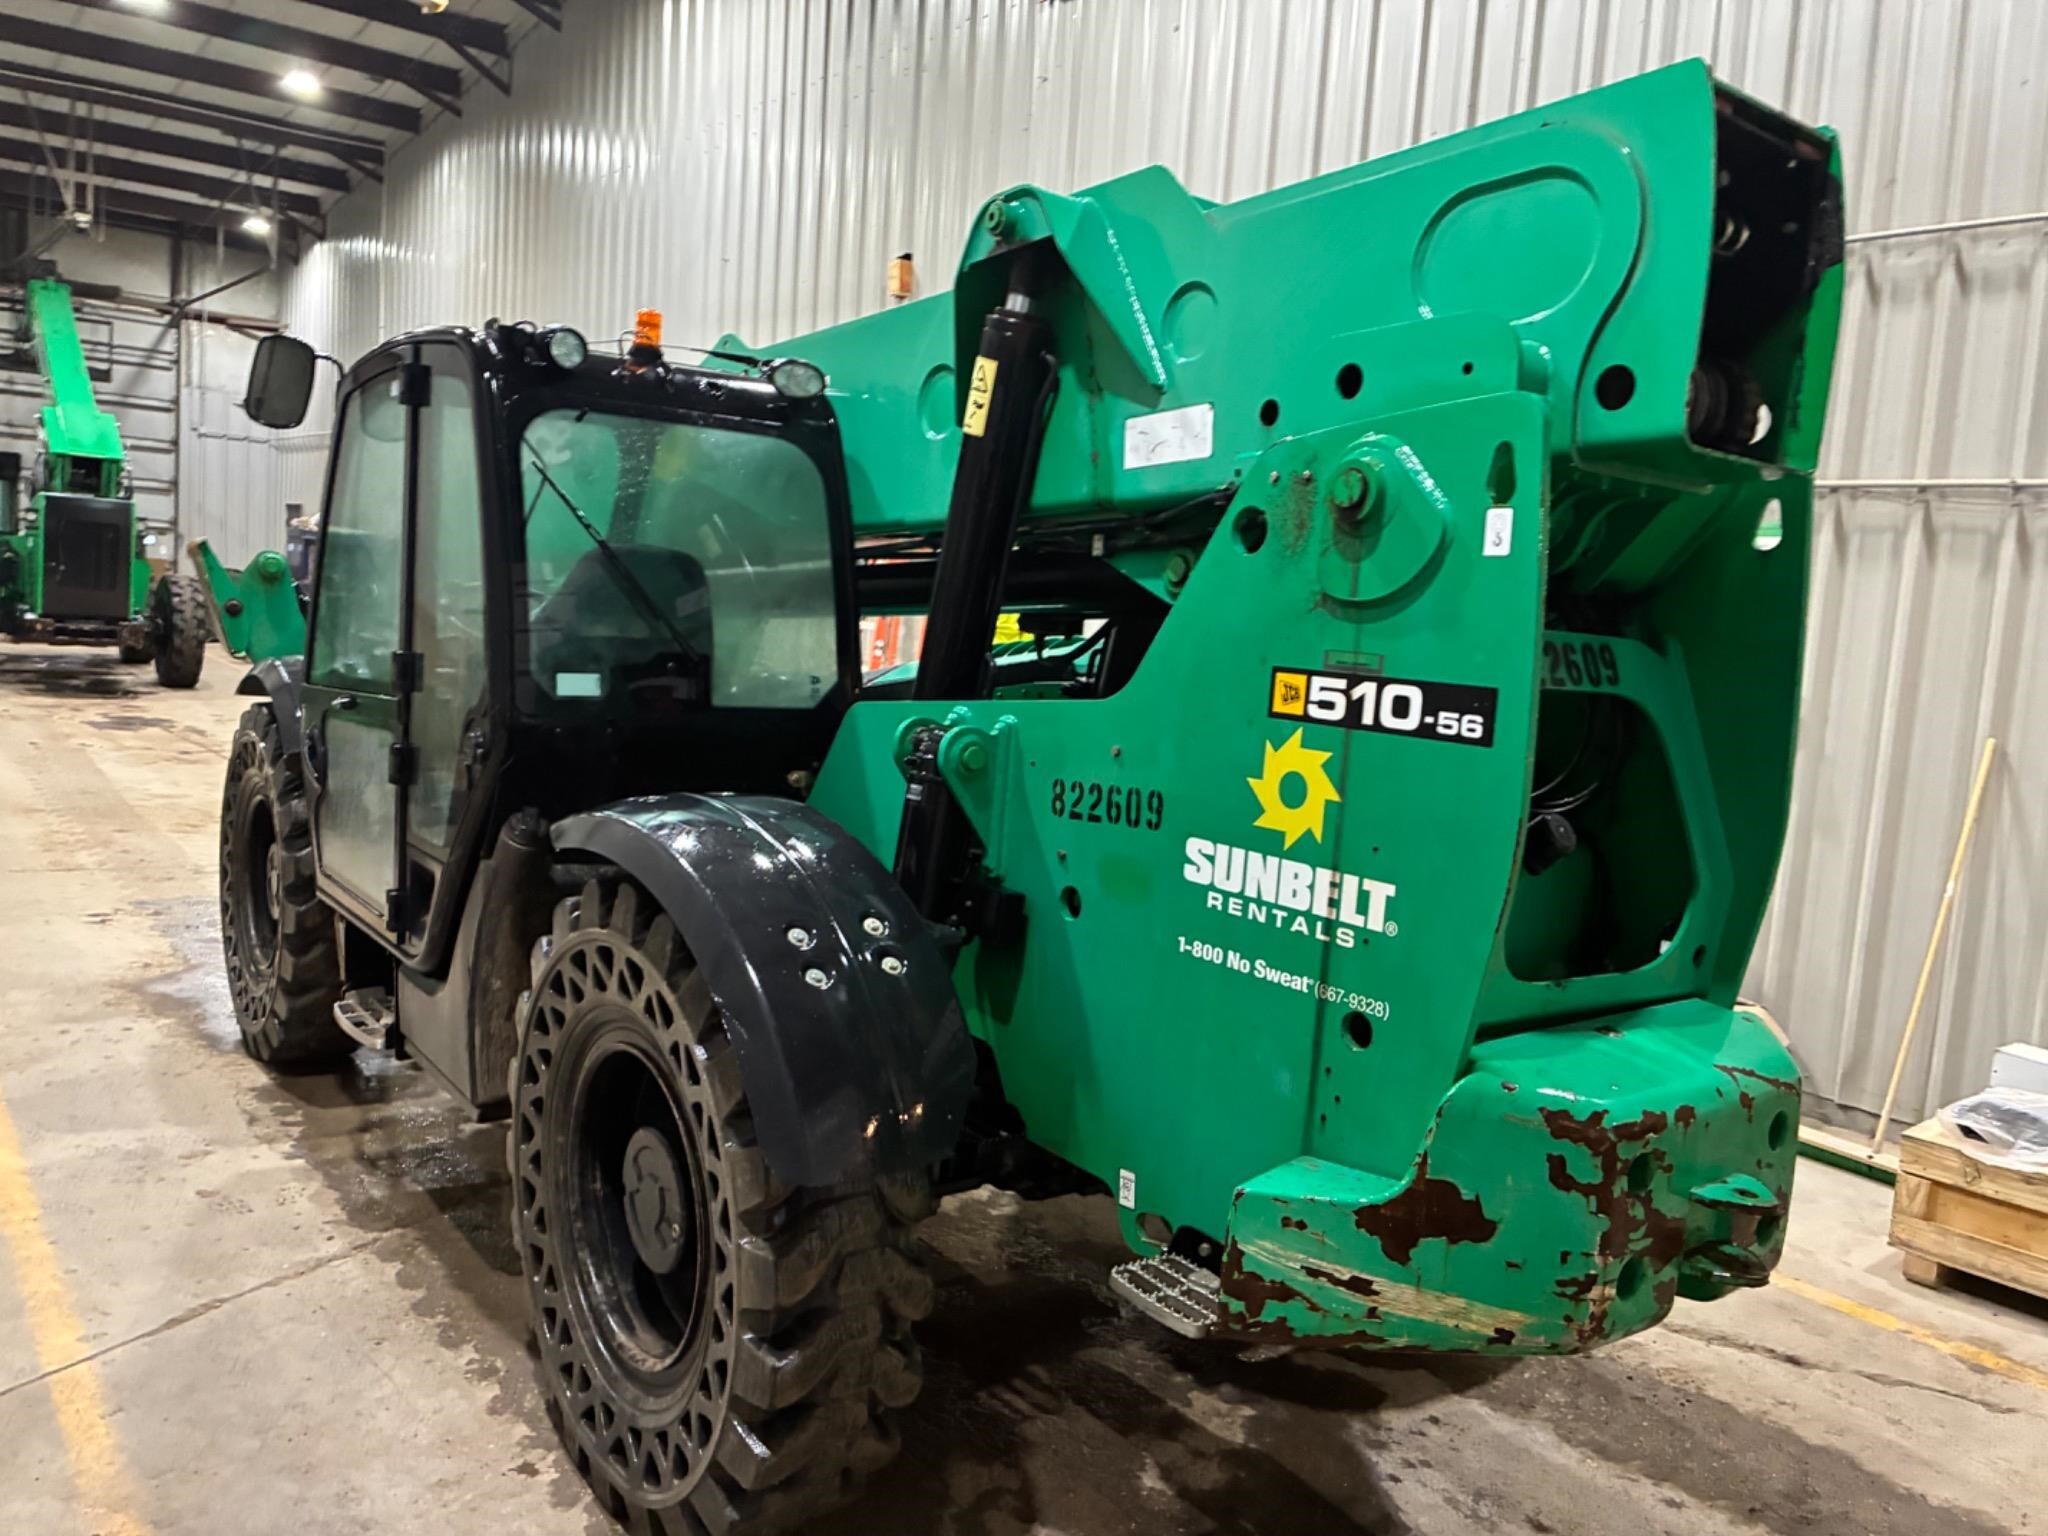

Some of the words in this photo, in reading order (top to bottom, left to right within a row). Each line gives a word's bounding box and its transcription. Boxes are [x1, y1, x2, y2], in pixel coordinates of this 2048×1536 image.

[1051, 778, 1164, 832] 822609
[1183, 836, 1397, 934] SUNBELT
[1206, 890, 1356, 949] RENTALS
[1177, 935, 1224, 965] 1-800
[1226, 949, 1251, 974] No
[1314, 980, 1391, 1021] (667-9328)
